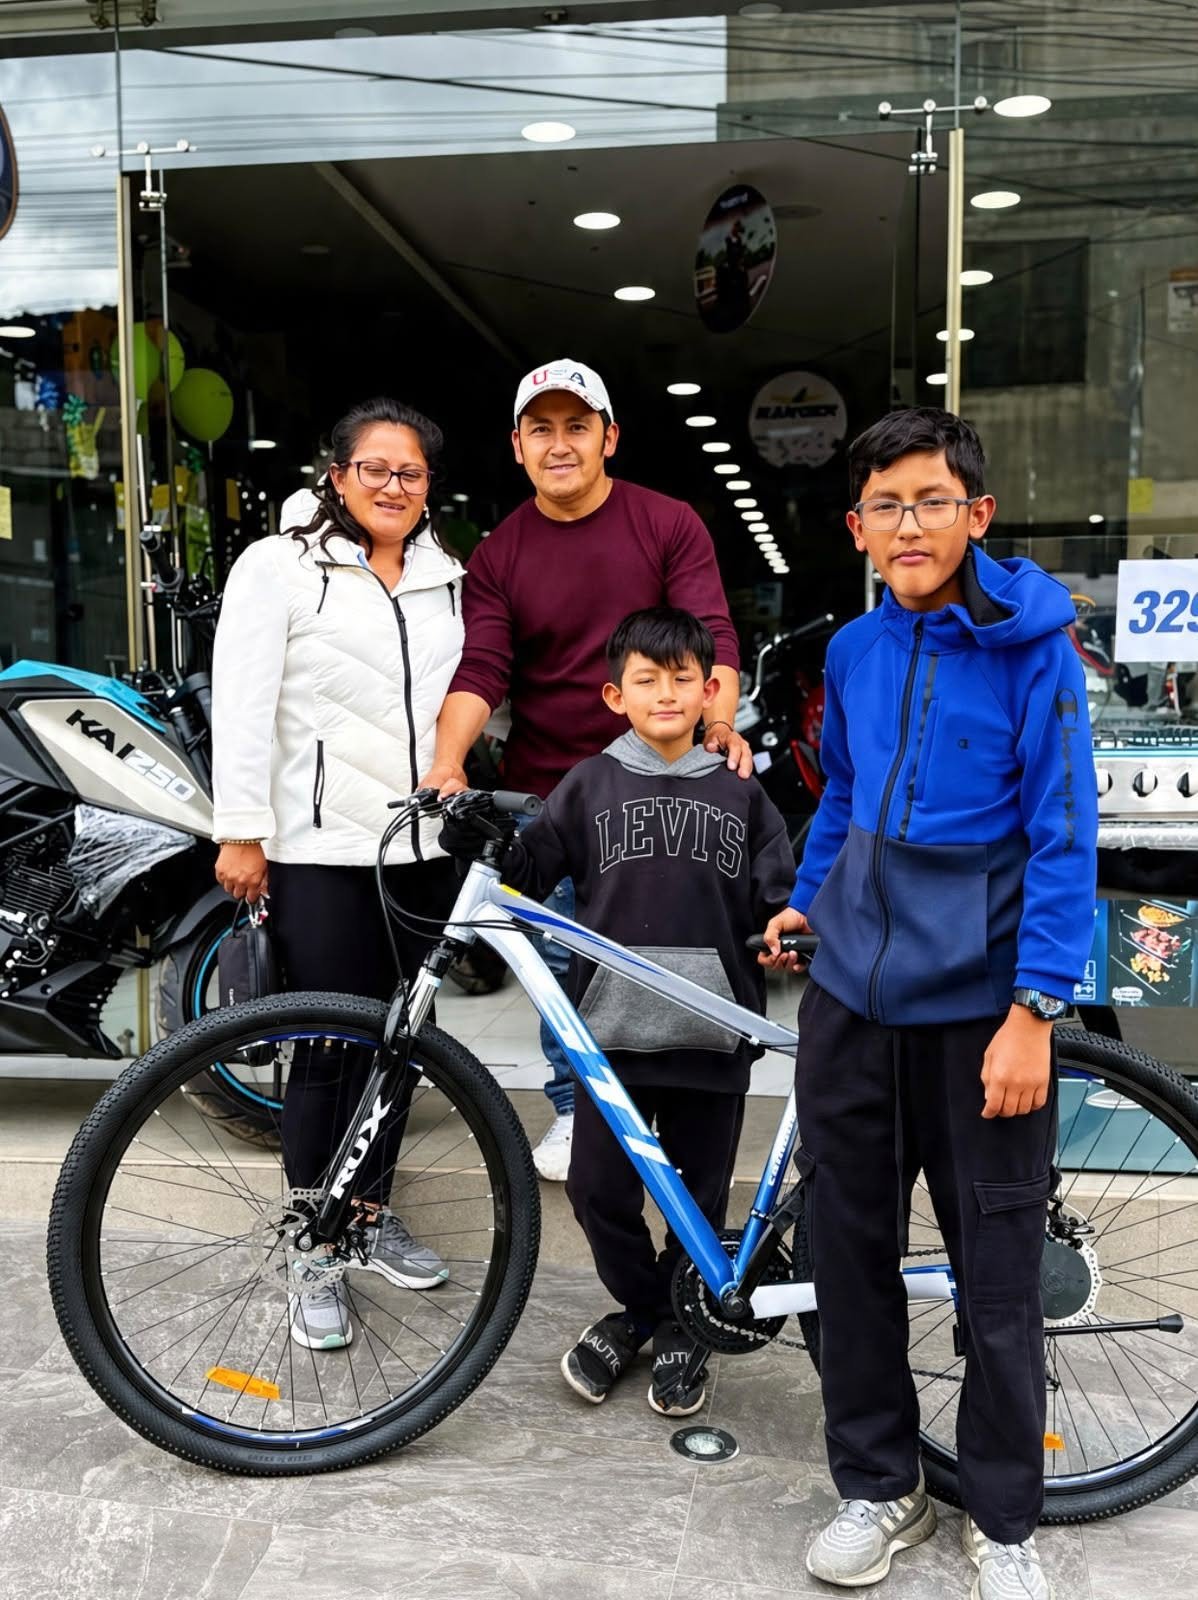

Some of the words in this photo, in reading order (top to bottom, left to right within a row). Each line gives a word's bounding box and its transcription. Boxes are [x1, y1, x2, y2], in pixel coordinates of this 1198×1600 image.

[532, 369, 586, 388] UA
[595, 796, 746, 879] LEVI'S
[329, 1094, 393, 1200] RUX
[652, 1351, 691, 1373] AUTI
